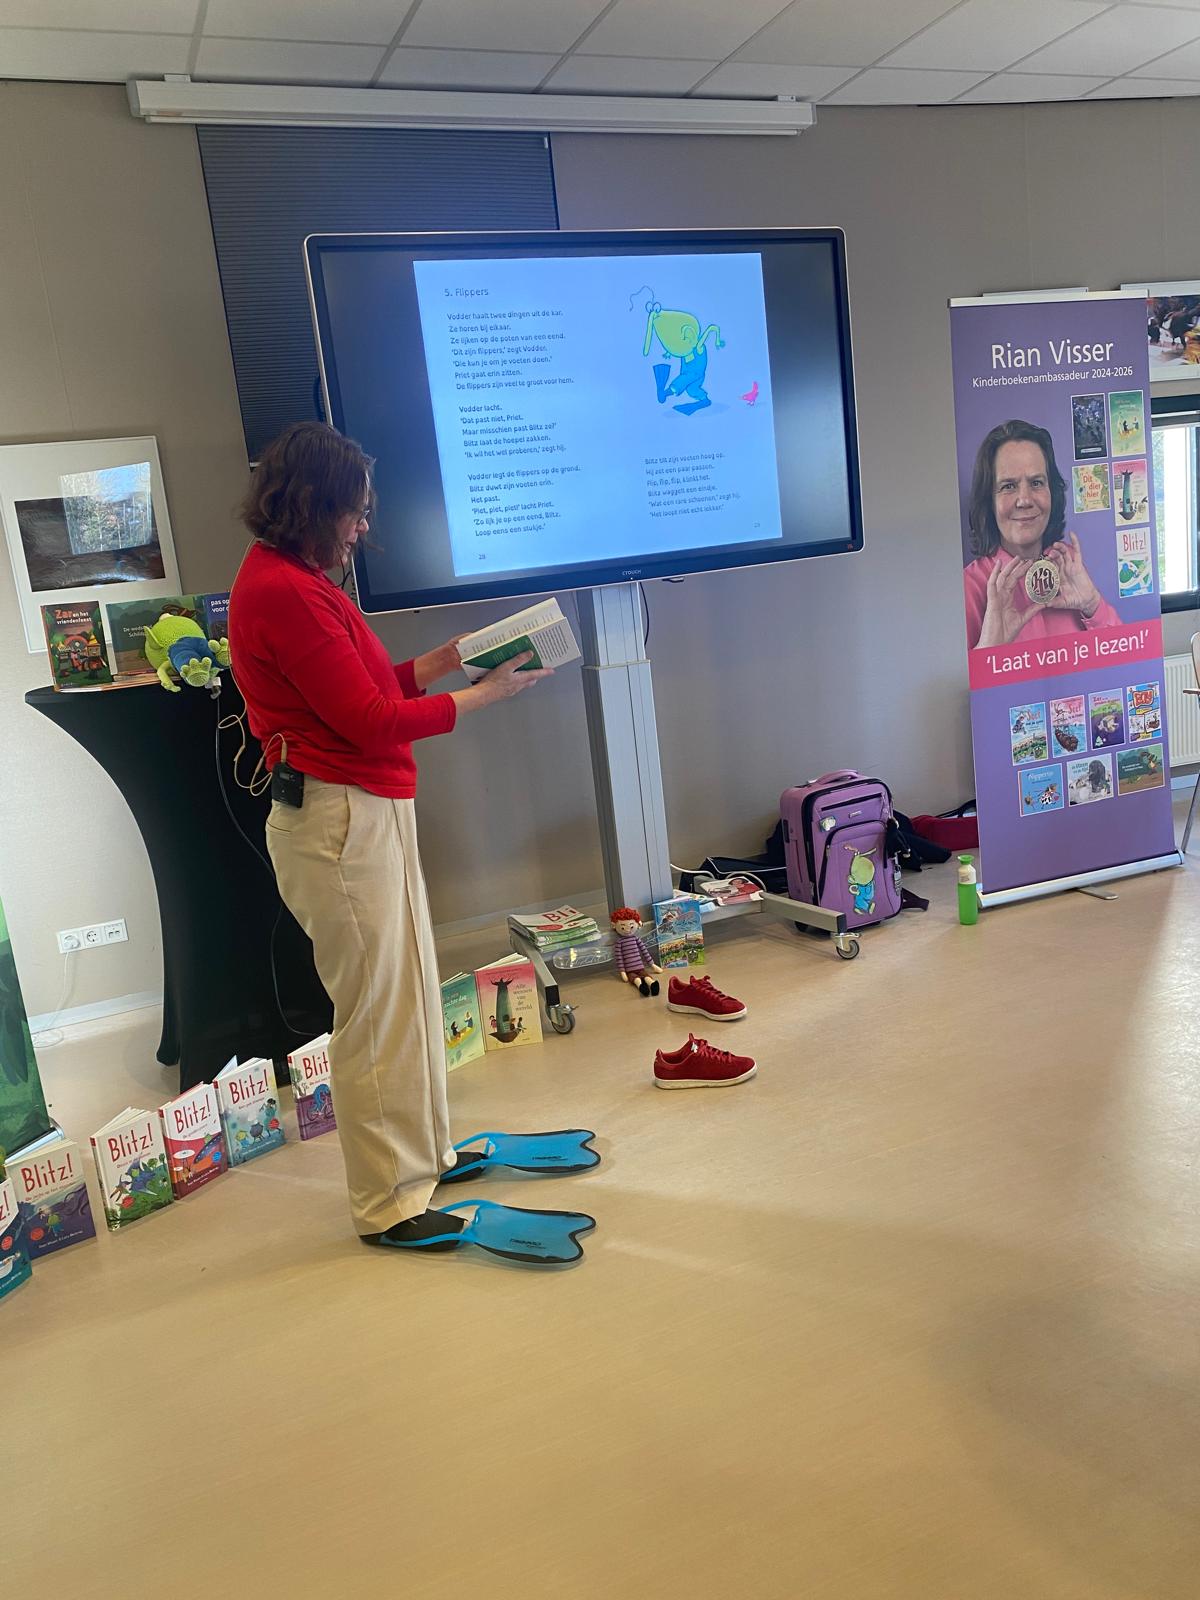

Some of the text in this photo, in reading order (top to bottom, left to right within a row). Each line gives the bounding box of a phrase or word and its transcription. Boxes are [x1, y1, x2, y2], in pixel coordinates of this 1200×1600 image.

[444, 288, 489, 298] 5. Flippers
[447, 313, 471, 321] Vodder
[472, 312, 489, 320] haalt
[507, 311, 531, 319] dingen
[541, 309, 550, 317] de
[460, 336, 478, 345] lijken
[490, 335, 498, 343] de
[500, 335, 519, 344] poten
[547, 332, 566, 340] eend.
[991, 339, 1113, 369] Rian Visser
[467, 382, 491, 391] flippers
[492, 380, 503, 389] zijn
[527, 378, 543, 388] groot
[973, 366, 1133, 388] Kinderboekenambassadeur 2024-2026
[1123, 532, 1147, 551] Blitz!
[55, 609, 73, 619] Zar
[986, 629, 1149, 674] 'Laat van je lezen!'
[541, 908, 577, 922] Bli
[303, 1051, 328, 1079] Blit
[229, 1069, 269, 1105] Blitz!
[174, 1094, 211, 1134] Blitz!
[108, 1123, 154, 1163] Blitz!
[20, 1153, 74, 1193] Blitz!
